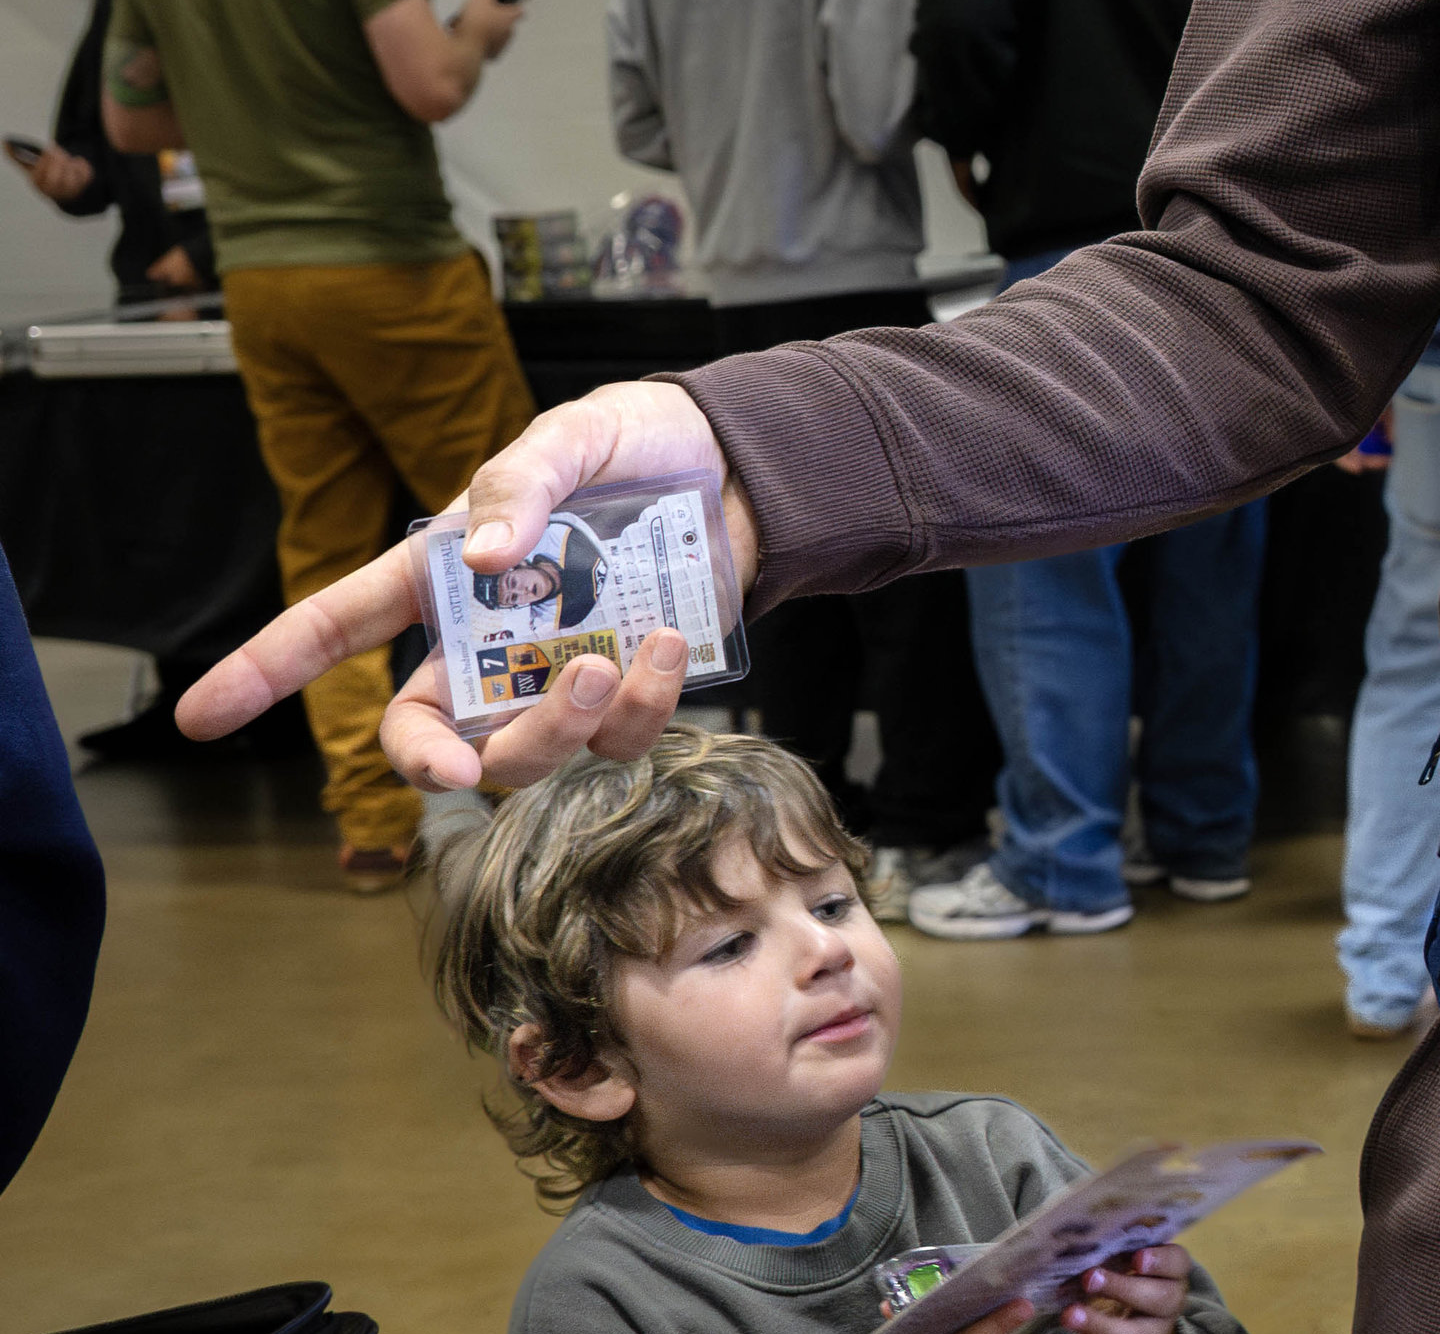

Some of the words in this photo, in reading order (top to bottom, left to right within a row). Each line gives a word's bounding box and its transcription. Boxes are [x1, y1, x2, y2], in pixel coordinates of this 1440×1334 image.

[448, 586, 465, 626] SCOTTIE
[483, 657, 505, 669] 7
[517, 673, 537, 695] RW
